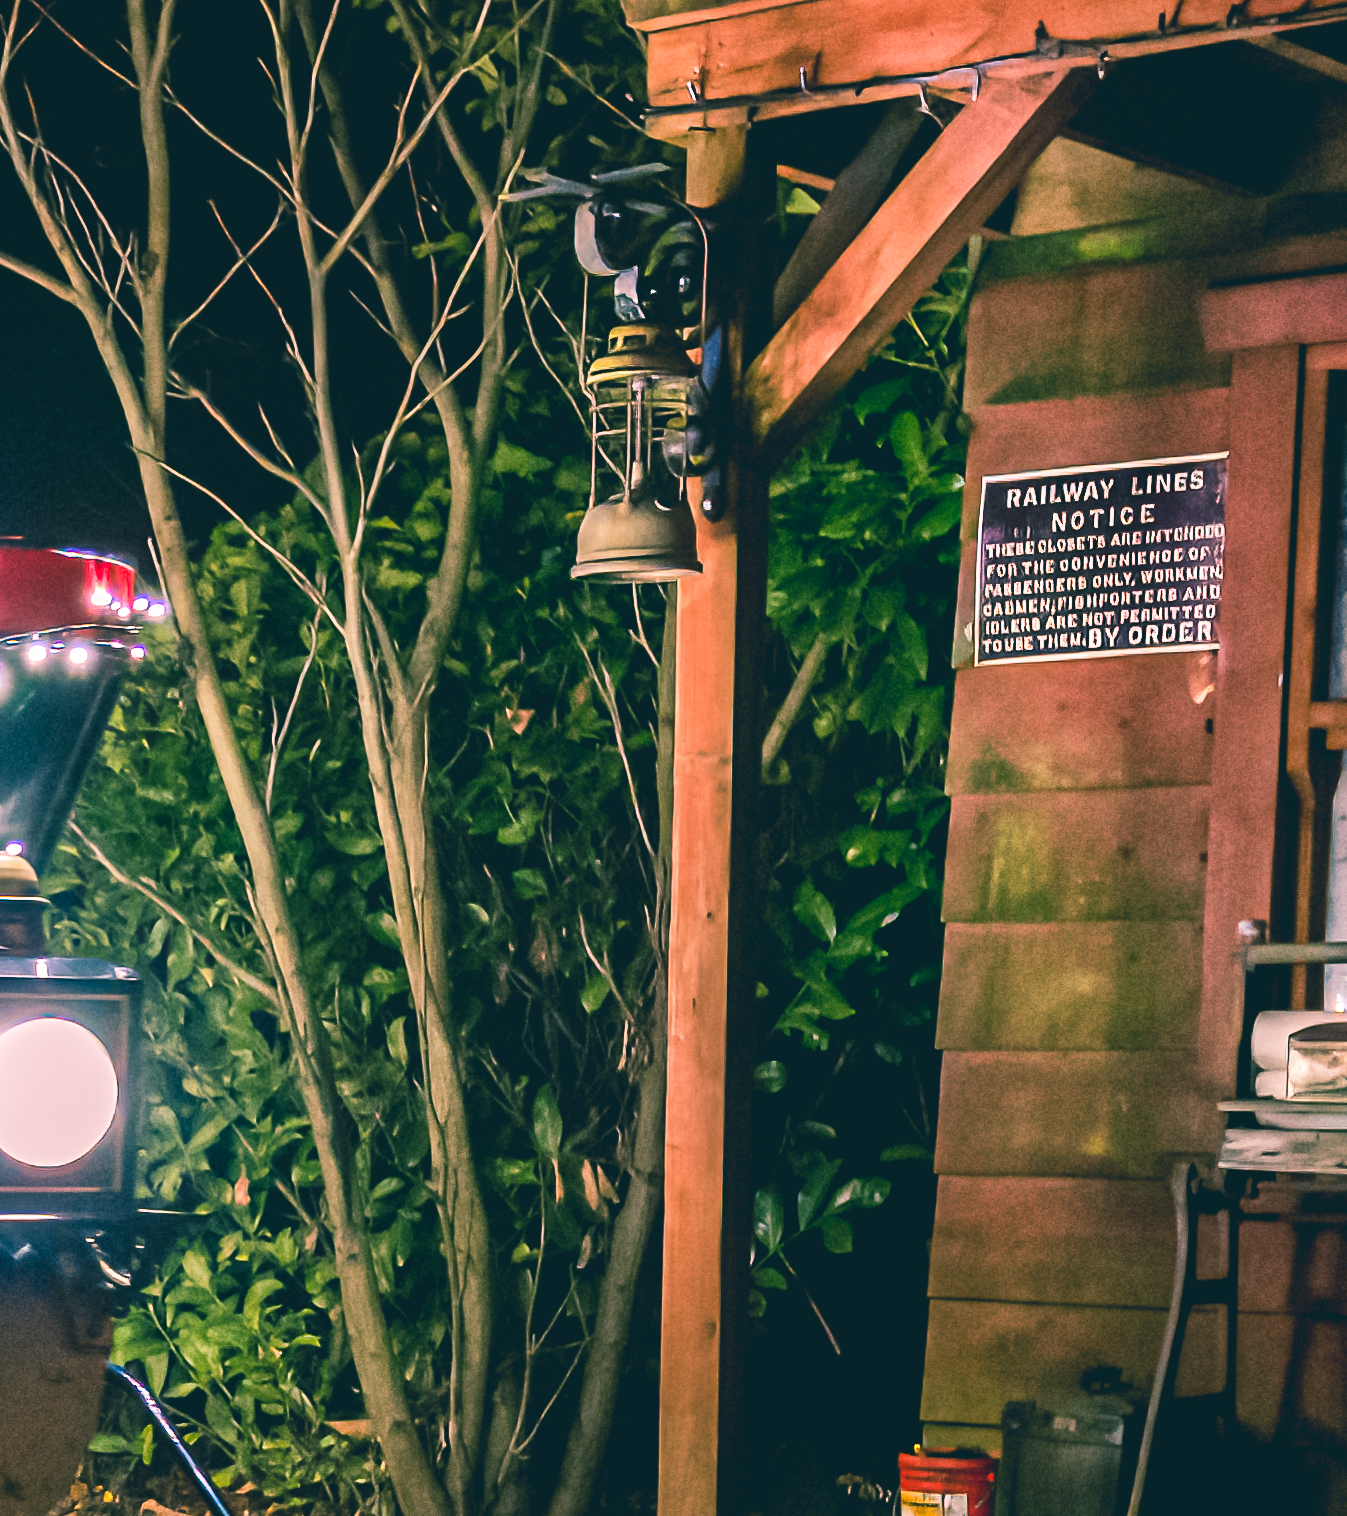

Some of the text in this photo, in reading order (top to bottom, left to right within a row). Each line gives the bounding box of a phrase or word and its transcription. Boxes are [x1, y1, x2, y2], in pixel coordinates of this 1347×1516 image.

[1007, 469, 1204, 508] RAILWAY LINES
[1051, 503, 1155, 533] NOTICE
[1038, 535, 1105, 553] CLOSETS
[1111, 531, 1142, 546] ARE
[987, 546, 1210, 579] FOR THE CONVENIENCE OF
[984, 576, 1087, 598] PASSENGERS
[1182, 584, 1221, 602] AND
[1045, 613, 1078, 631] ARE
[1082, 610, 1115, 627] NOT
[1120, 604, 1216, 625] PERMITTED
[982, 637, 1003, 653] TO
[1088, 626, 1119, 649] BY
[1128, 620, 1212, 645] ORDER
